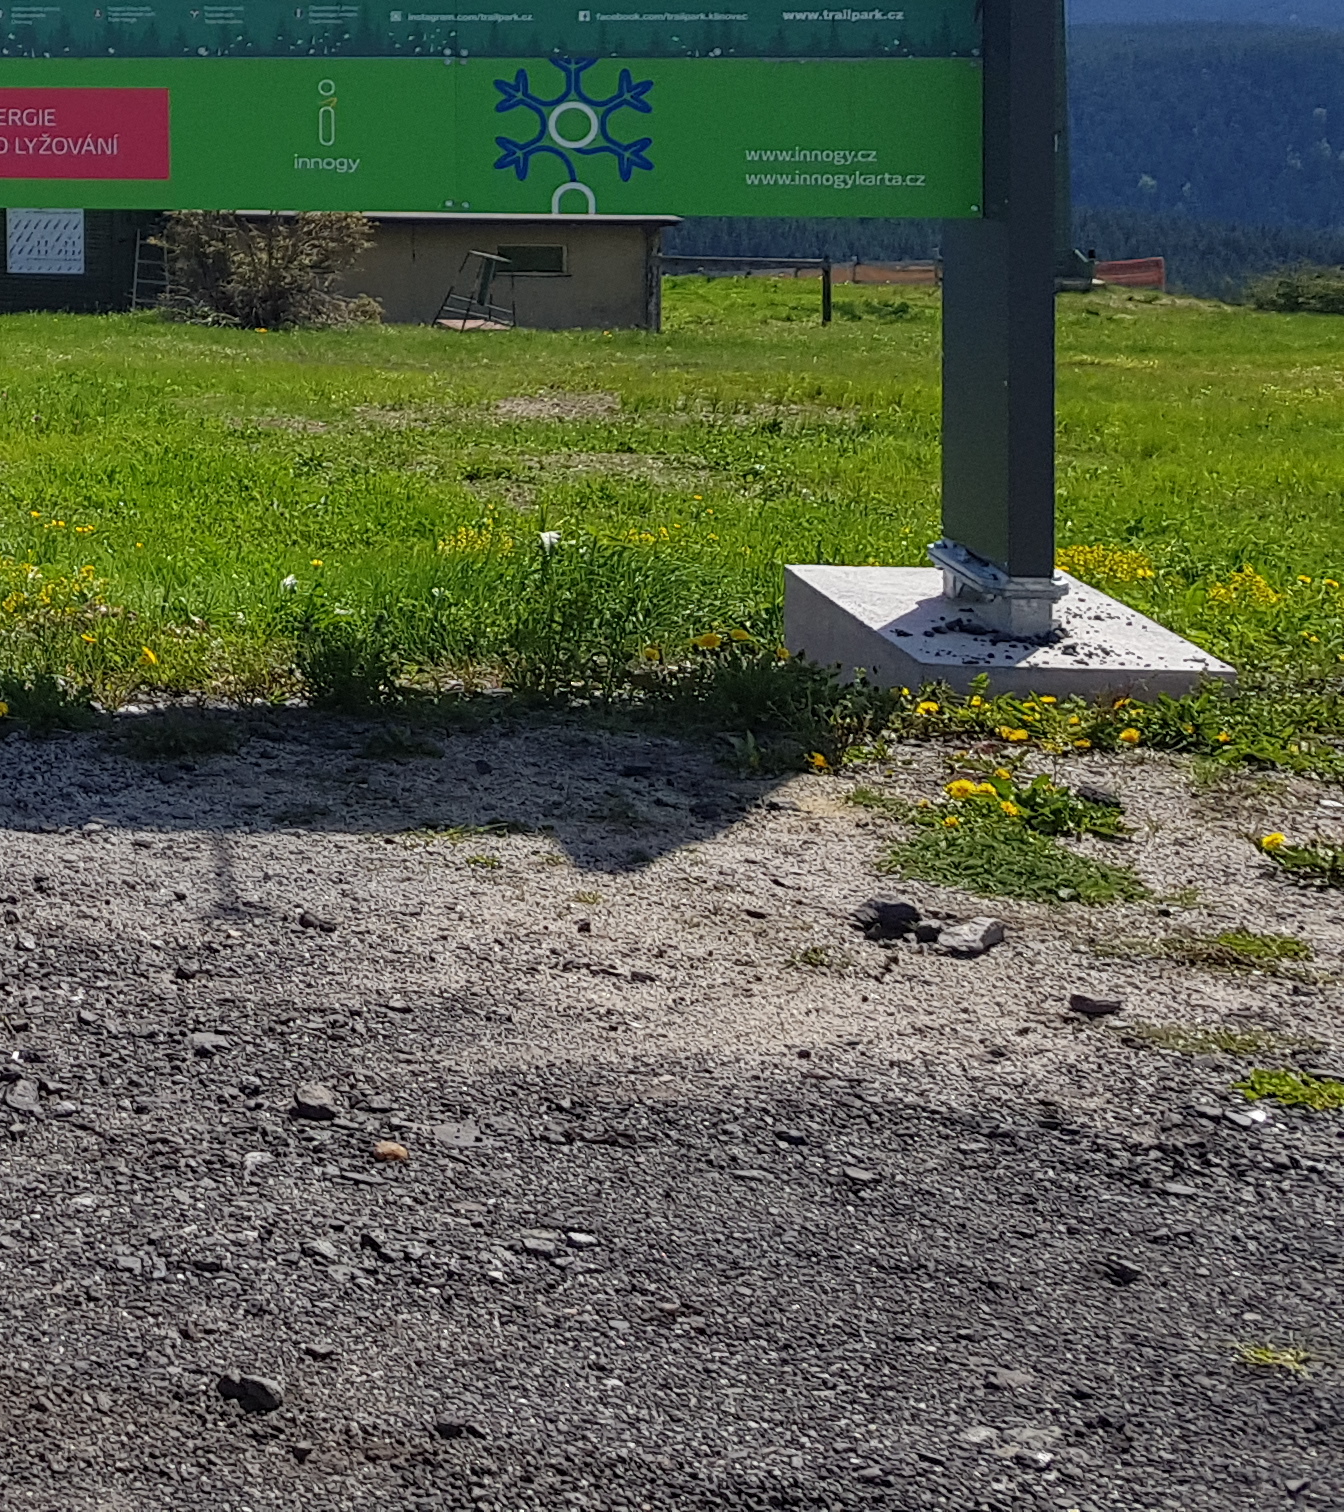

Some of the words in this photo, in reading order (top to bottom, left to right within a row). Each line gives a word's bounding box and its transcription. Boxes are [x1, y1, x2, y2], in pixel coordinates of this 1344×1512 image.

[783, 10, 903, 21] www.trailpark.cz
[16, 134, 118, 154] LYŽOVÁNÍ
[293, 154, 360, 172] innogy
[746, 149, 877, 165] www.innogy.cz
[746, 172, 926, 188] www.innogykarta.cz
